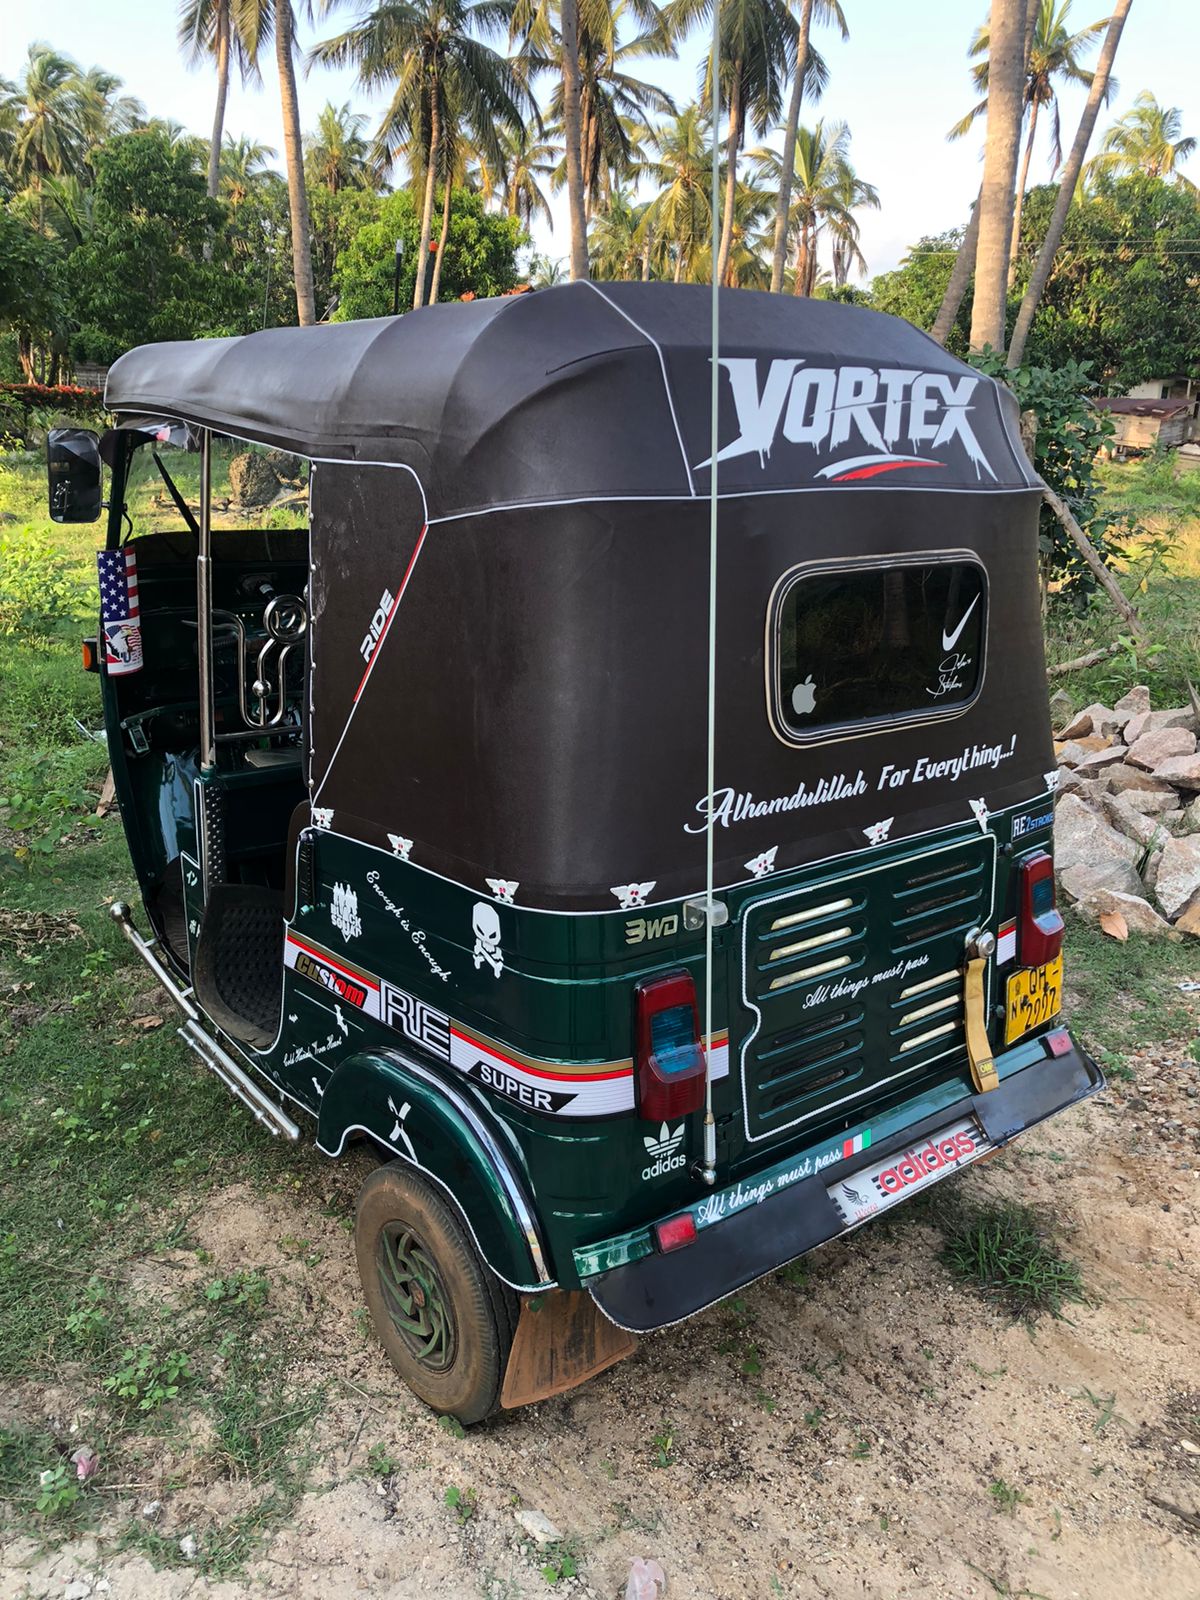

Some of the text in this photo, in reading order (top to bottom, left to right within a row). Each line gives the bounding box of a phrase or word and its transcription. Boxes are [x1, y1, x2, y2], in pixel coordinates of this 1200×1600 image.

[693, 357, 998, 481] VORTEX
[684, 769, 867, 834] Alhamdulillah
[877, 764, 911, 791] For
[296, 953, 365, 1008] Custom
[802, 984, 831, 1010] All
[829, 977, 870, 999] things
[871, 959, 904, 984] must
[480, 1063, 553, 1111] SUPER
[642, 1153, 687, 1181] adidas
[697, 1148, 843, 1224] All things must pass
[879, 1131, 977, 1195] adidas
